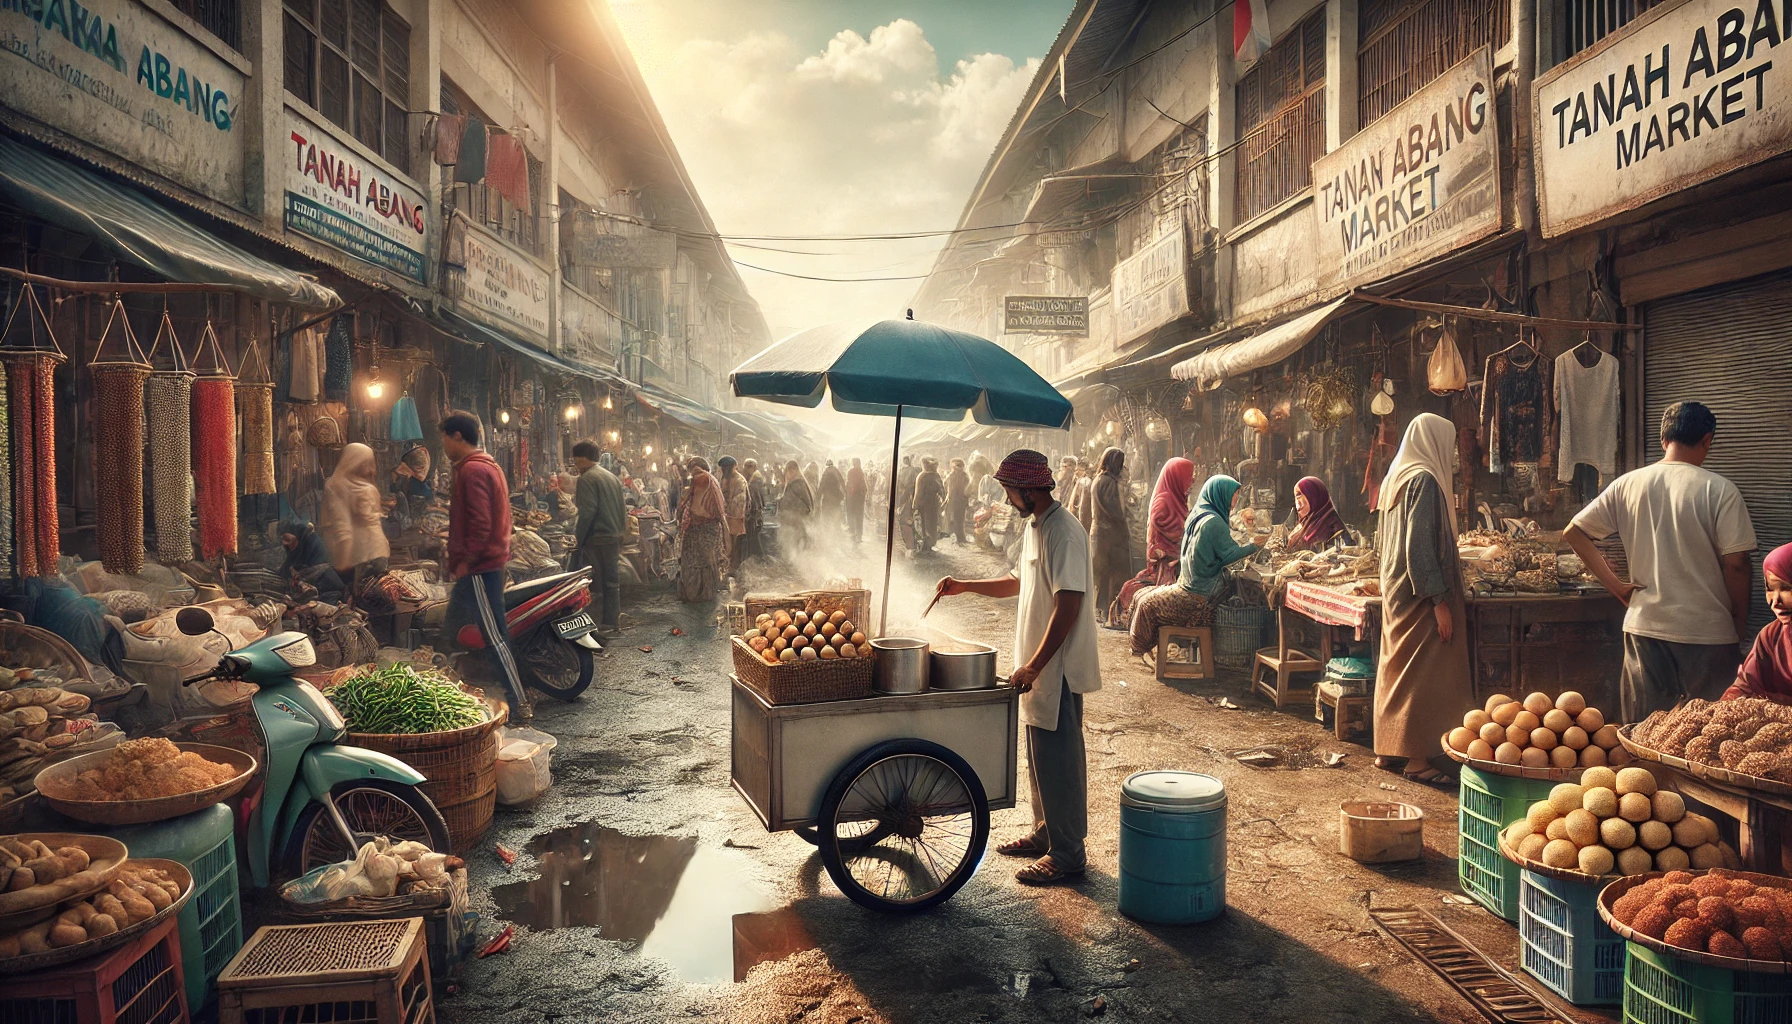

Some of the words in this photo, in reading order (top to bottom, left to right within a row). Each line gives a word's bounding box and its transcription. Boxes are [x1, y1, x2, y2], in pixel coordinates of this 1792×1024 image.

[137, 44, 232, 132] ABANG
[1391, 82, 1486, 185] ABANG
[1552, 43, 1670, 149] TANAH
[1616, 60, 1773, 170] MARKET
[291, 130, 361, 204] TANAH
[1341, 164, 1440, 256] MARKET
